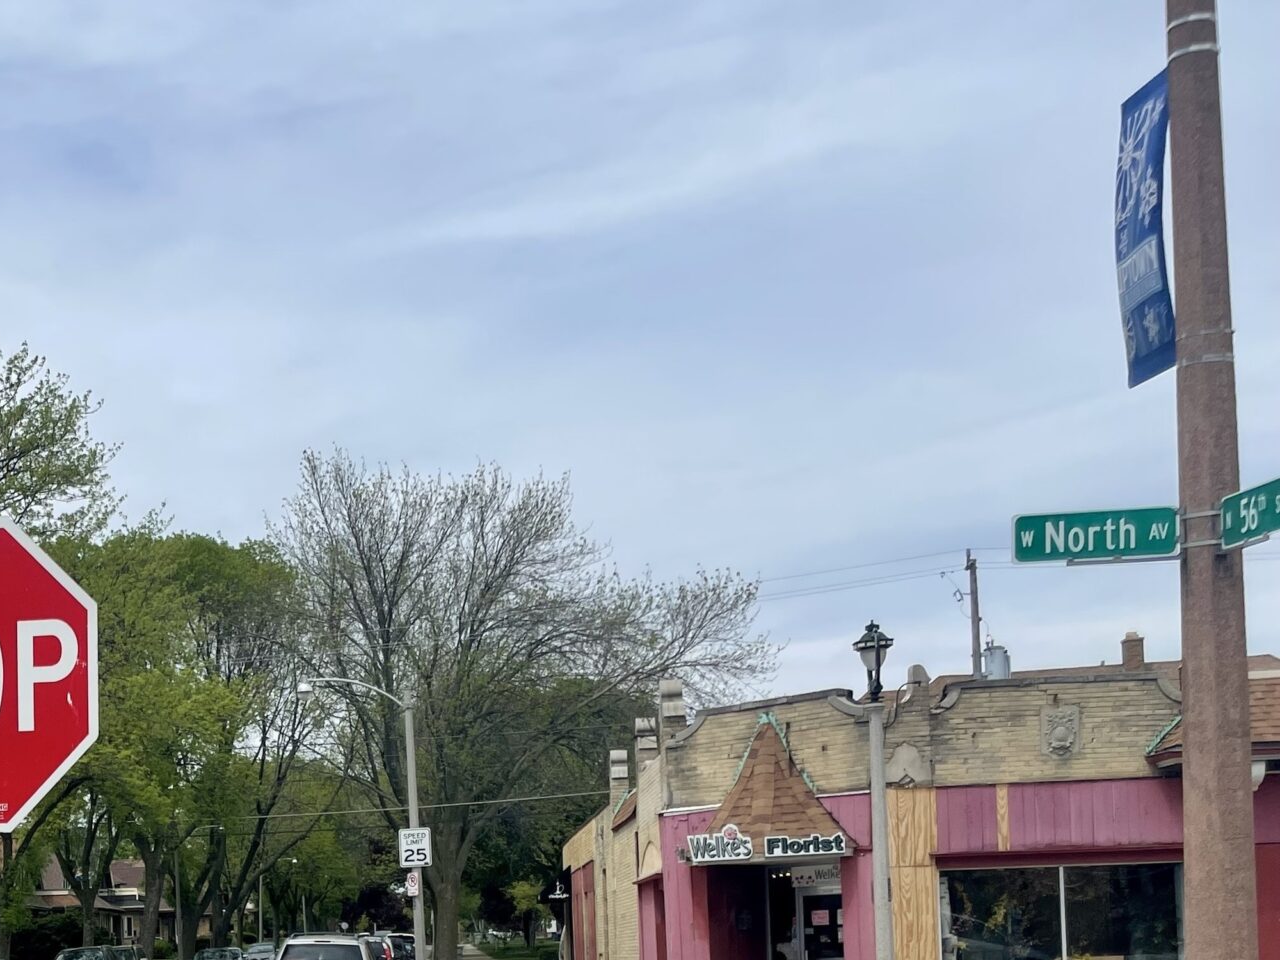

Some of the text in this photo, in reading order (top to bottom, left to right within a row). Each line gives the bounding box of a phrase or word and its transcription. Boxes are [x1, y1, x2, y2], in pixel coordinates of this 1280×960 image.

[1239, 493, 1267, 534] 56th
[1021, 517, 1169, 554] W North AV
[404, 848, 427, 862] 25
[766, 835, 844, 854] Florist
